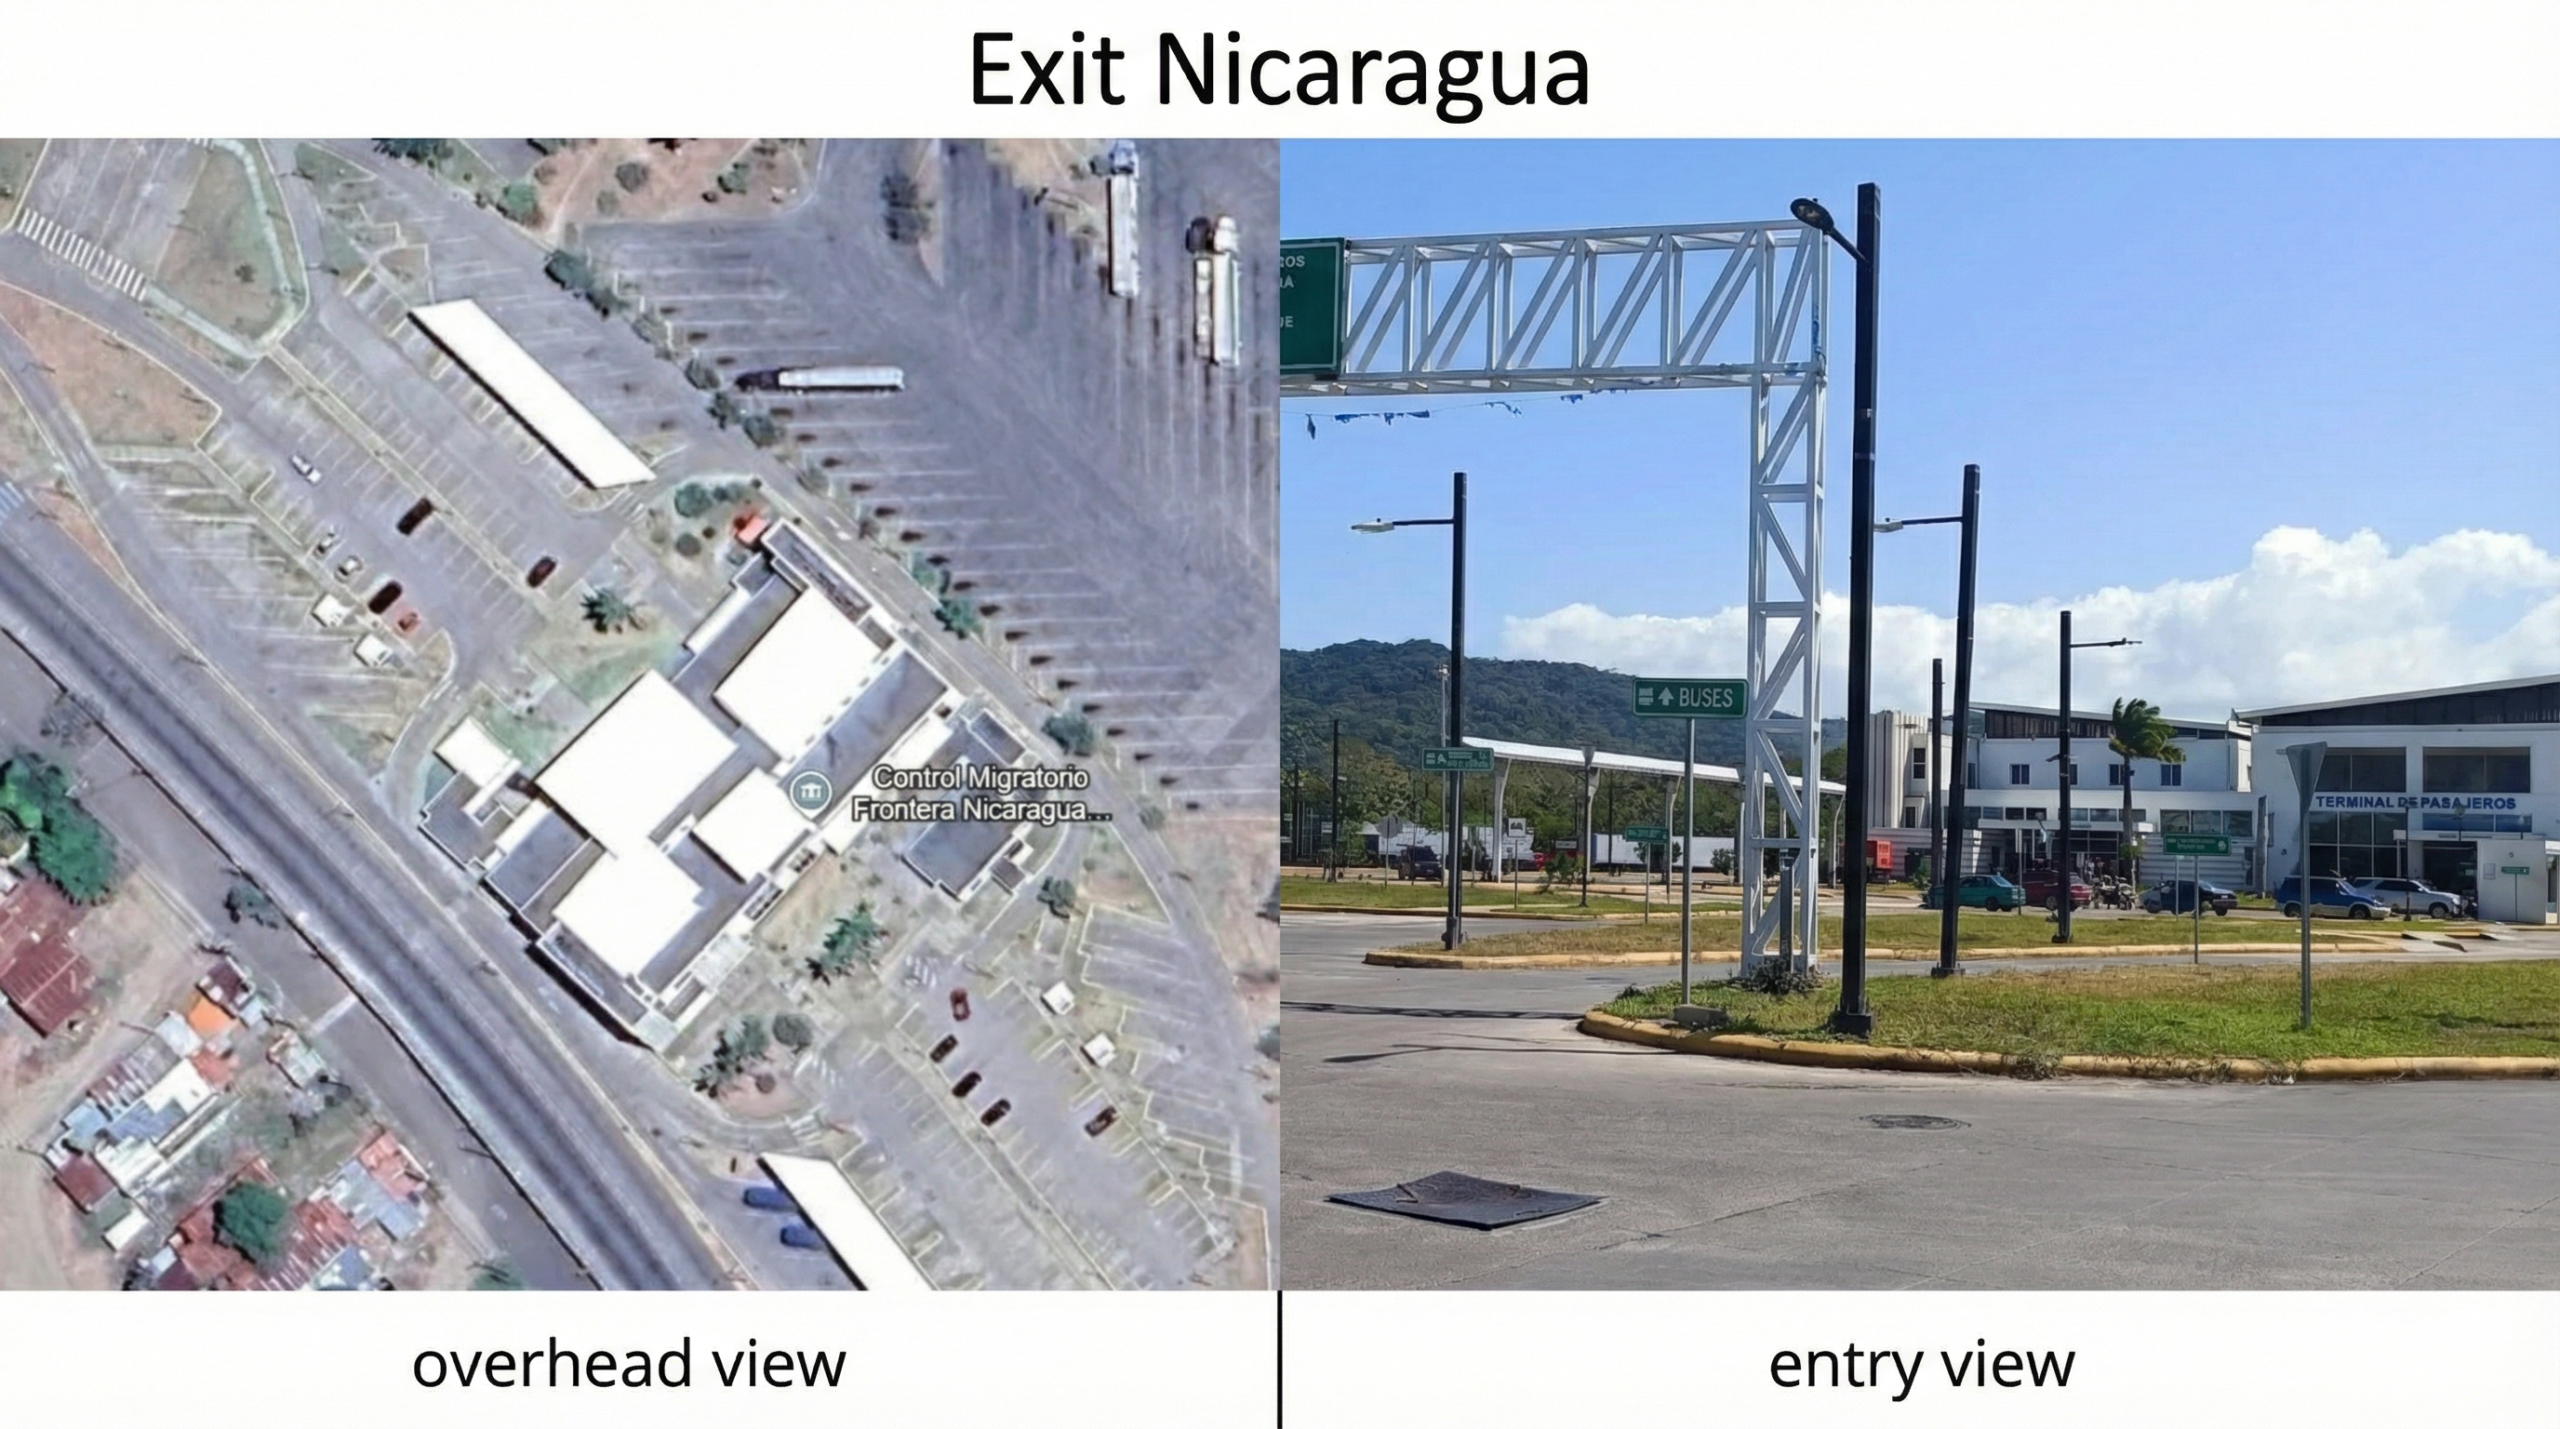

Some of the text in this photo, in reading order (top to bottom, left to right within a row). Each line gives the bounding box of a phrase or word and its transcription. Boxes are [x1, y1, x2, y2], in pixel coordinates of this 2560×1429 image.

[1679, 687, 1733, 708] BUSES
[2316, 796, 2517, 810] TERMINAL DE PASAJEROS
